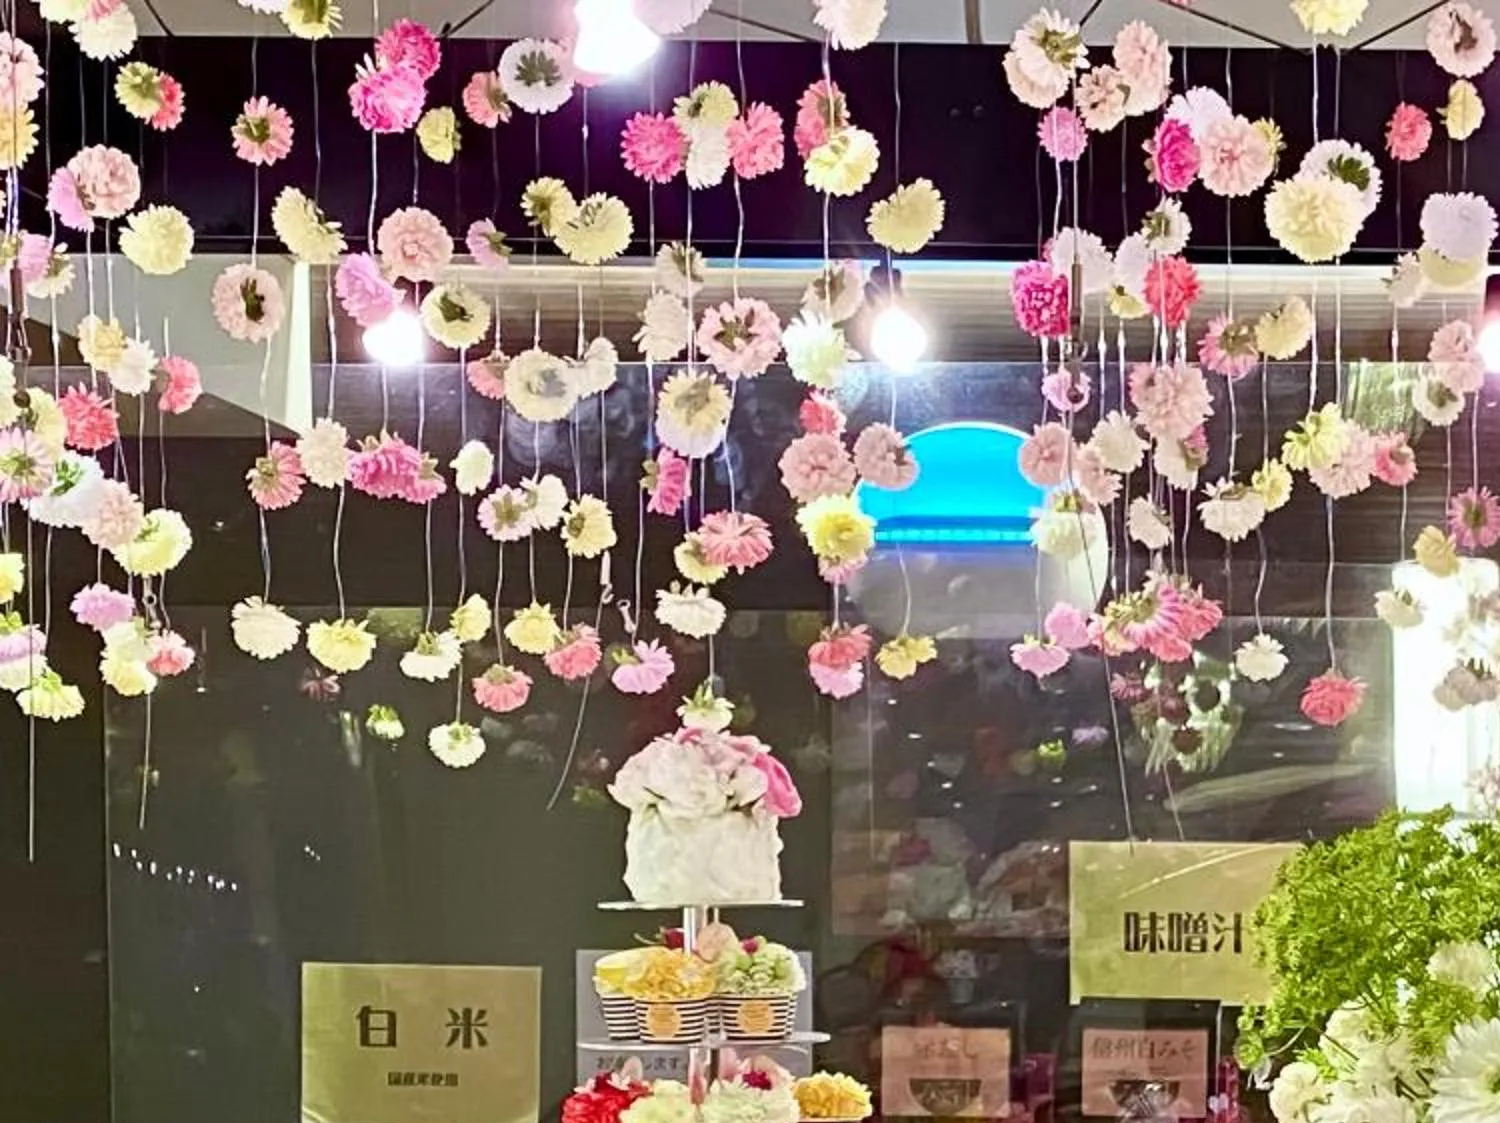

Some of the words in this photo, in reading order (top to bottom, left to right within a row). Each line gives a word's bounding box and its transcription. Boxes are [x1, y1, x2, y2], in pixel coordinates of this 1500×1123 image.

[1123, 911, 1250, 953] 味噌汁
[356, 1005, 489, 1048] 白米
